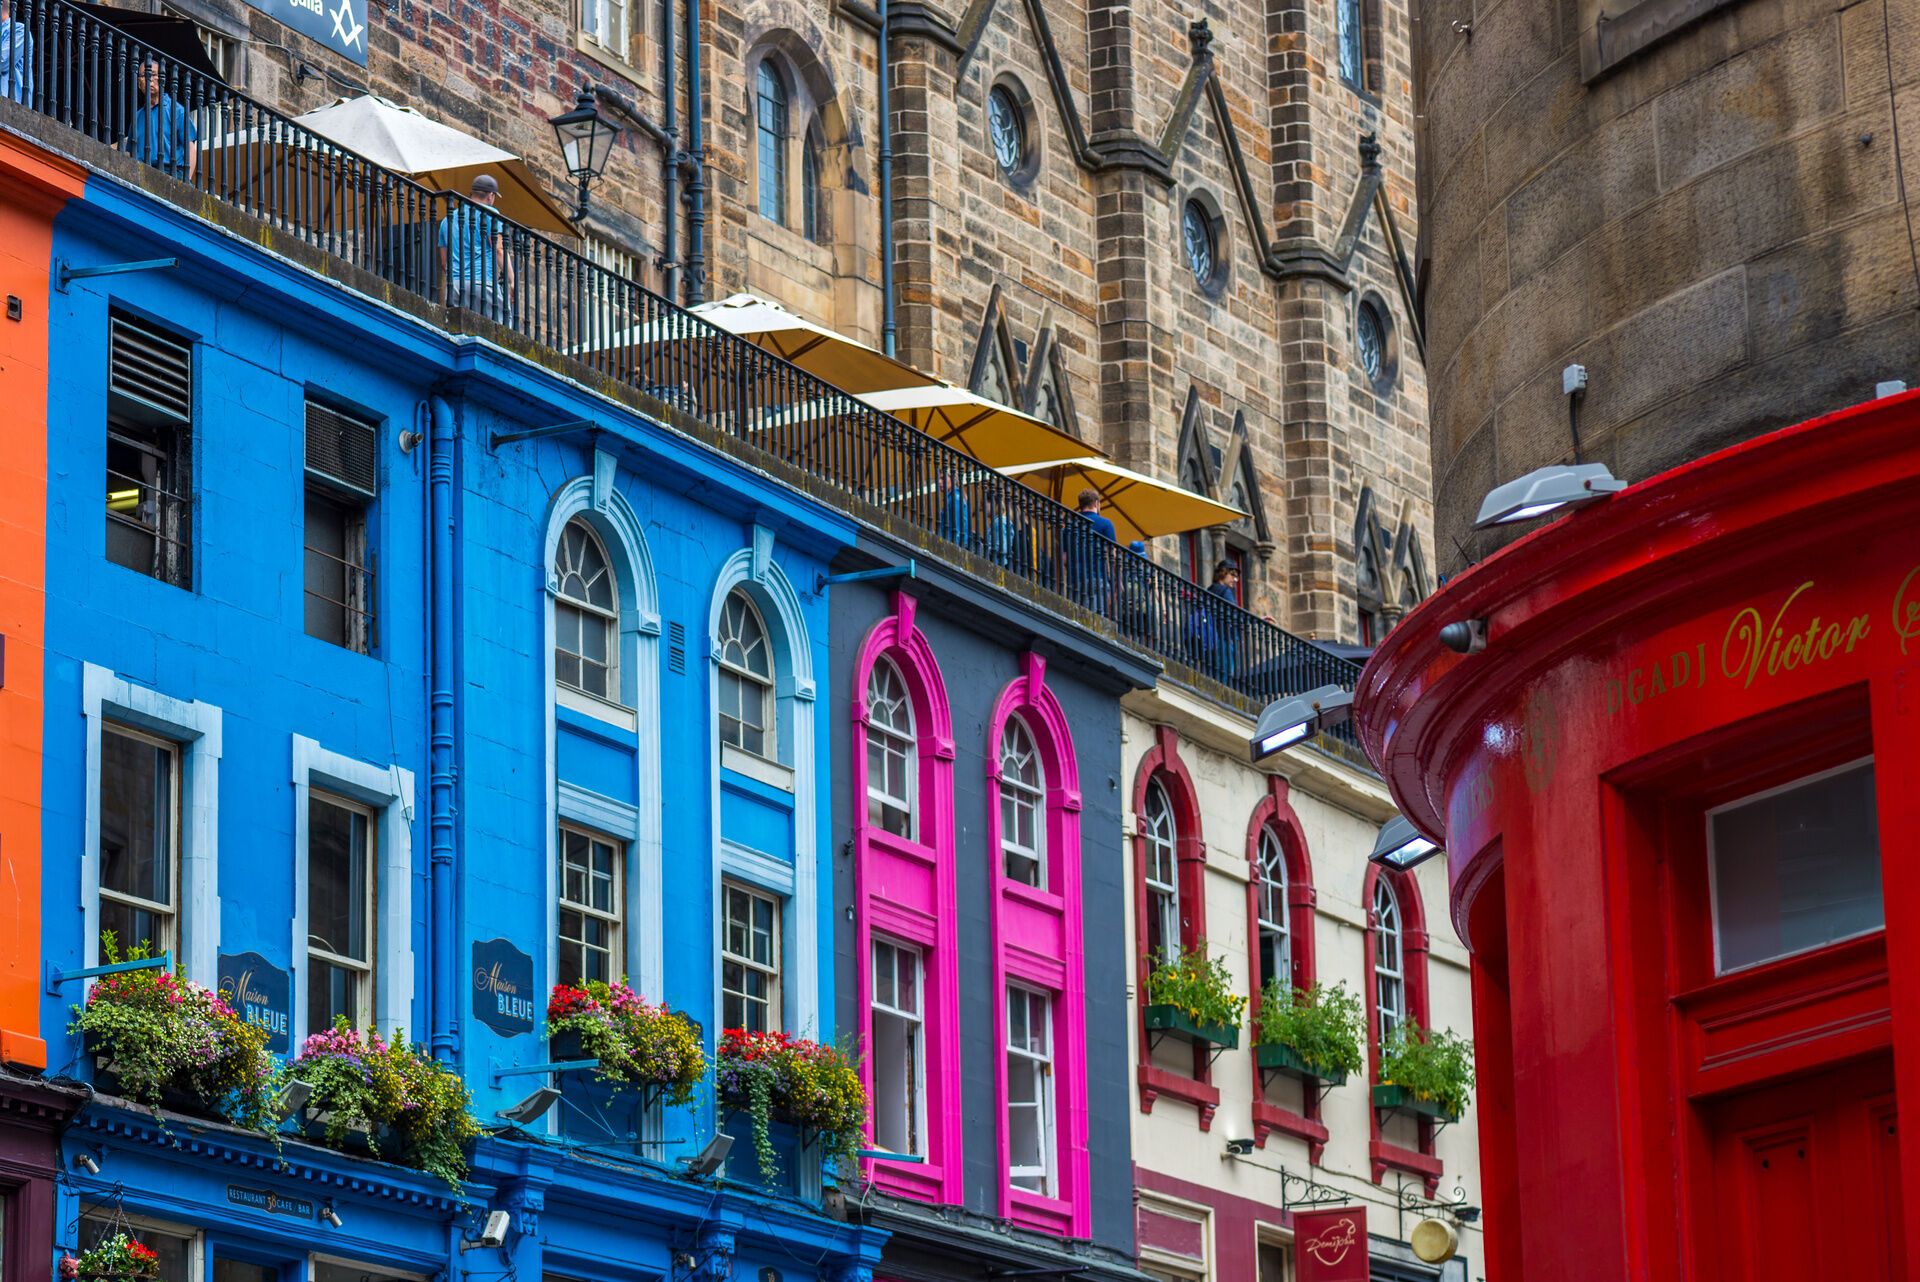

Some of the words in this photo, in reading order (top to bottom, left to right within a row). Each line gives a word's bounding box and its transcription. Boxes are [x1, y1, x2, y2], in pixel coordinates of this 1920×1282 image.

[1722, 580, 1871, 689] Victor
[219, 970, 268, 1008] Maison
[474, 961, 517, 996] Maison
[247, 1003, 288, 1035] BLEUE
[498, 993, 533, 1021] BLEUE
[229, 1189, 266, 1204] RESTAURANT
[267, 1194, 277, 1210] 38
[298, 1204, 310, 1215] BAR
[1305, 1233, 1355, 1253] Demijohn
